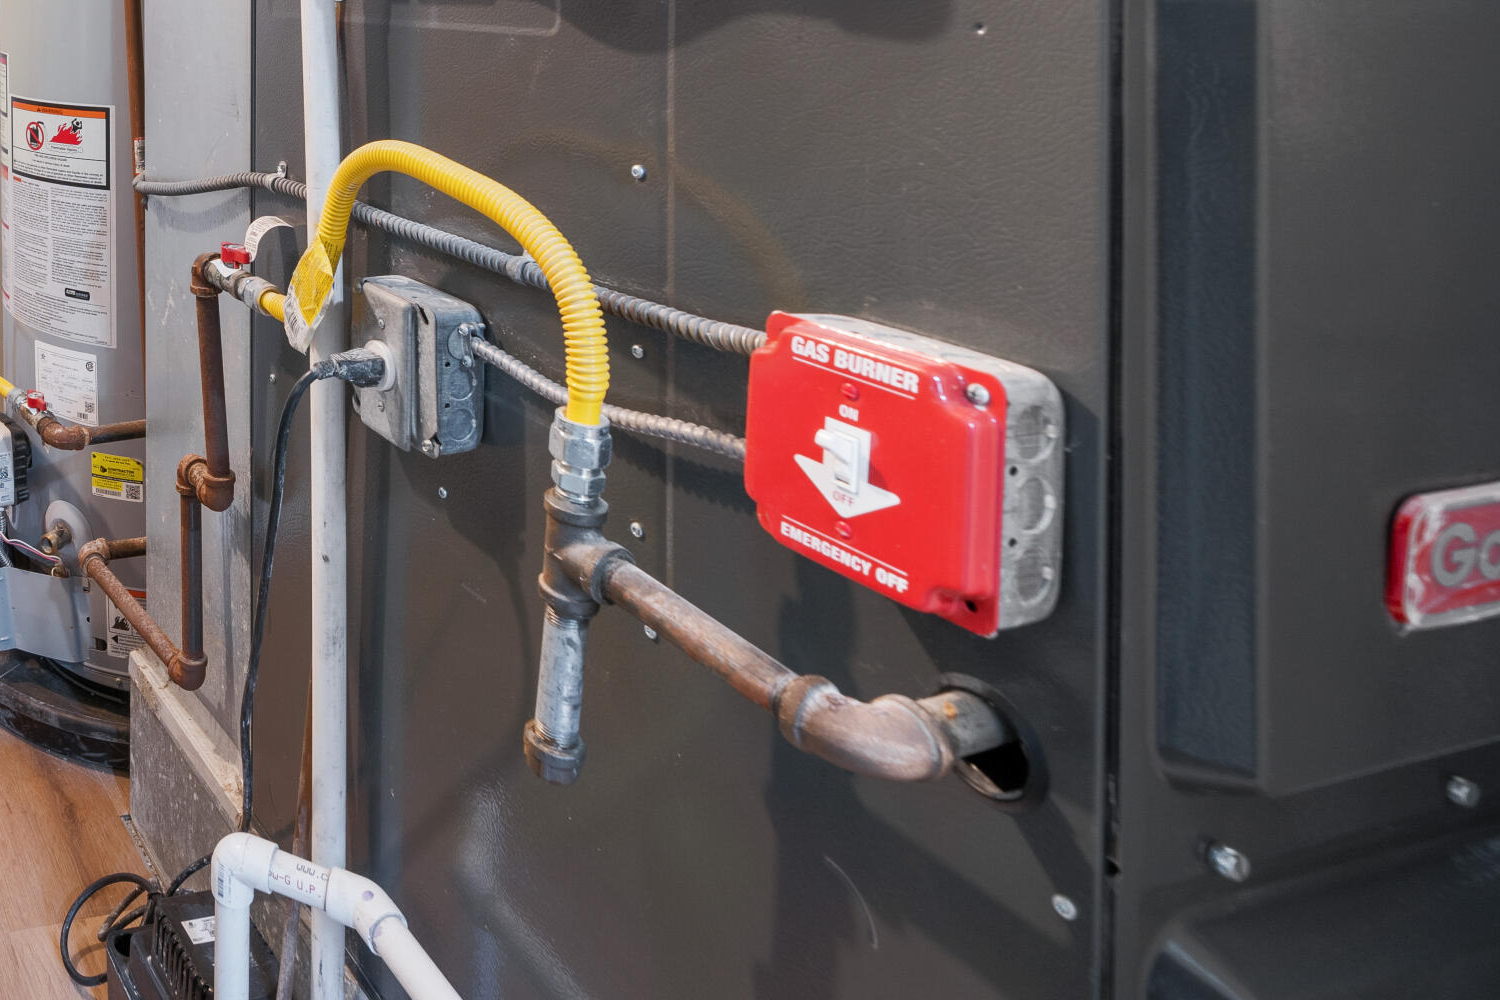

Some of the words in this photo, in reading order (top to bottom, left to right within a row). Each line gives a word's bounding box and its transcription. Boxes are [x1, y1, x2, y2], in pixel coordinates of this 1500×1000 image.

[790, 335, 831, 363] GAS
[833, 348, 920, 394] BURNER
[838, 403, 859, 422] ON
[832, 490, 855, 507] OFF
[780, 521, 872, 576] EMERGENCY
[875, 567, 909, 593] OFF
